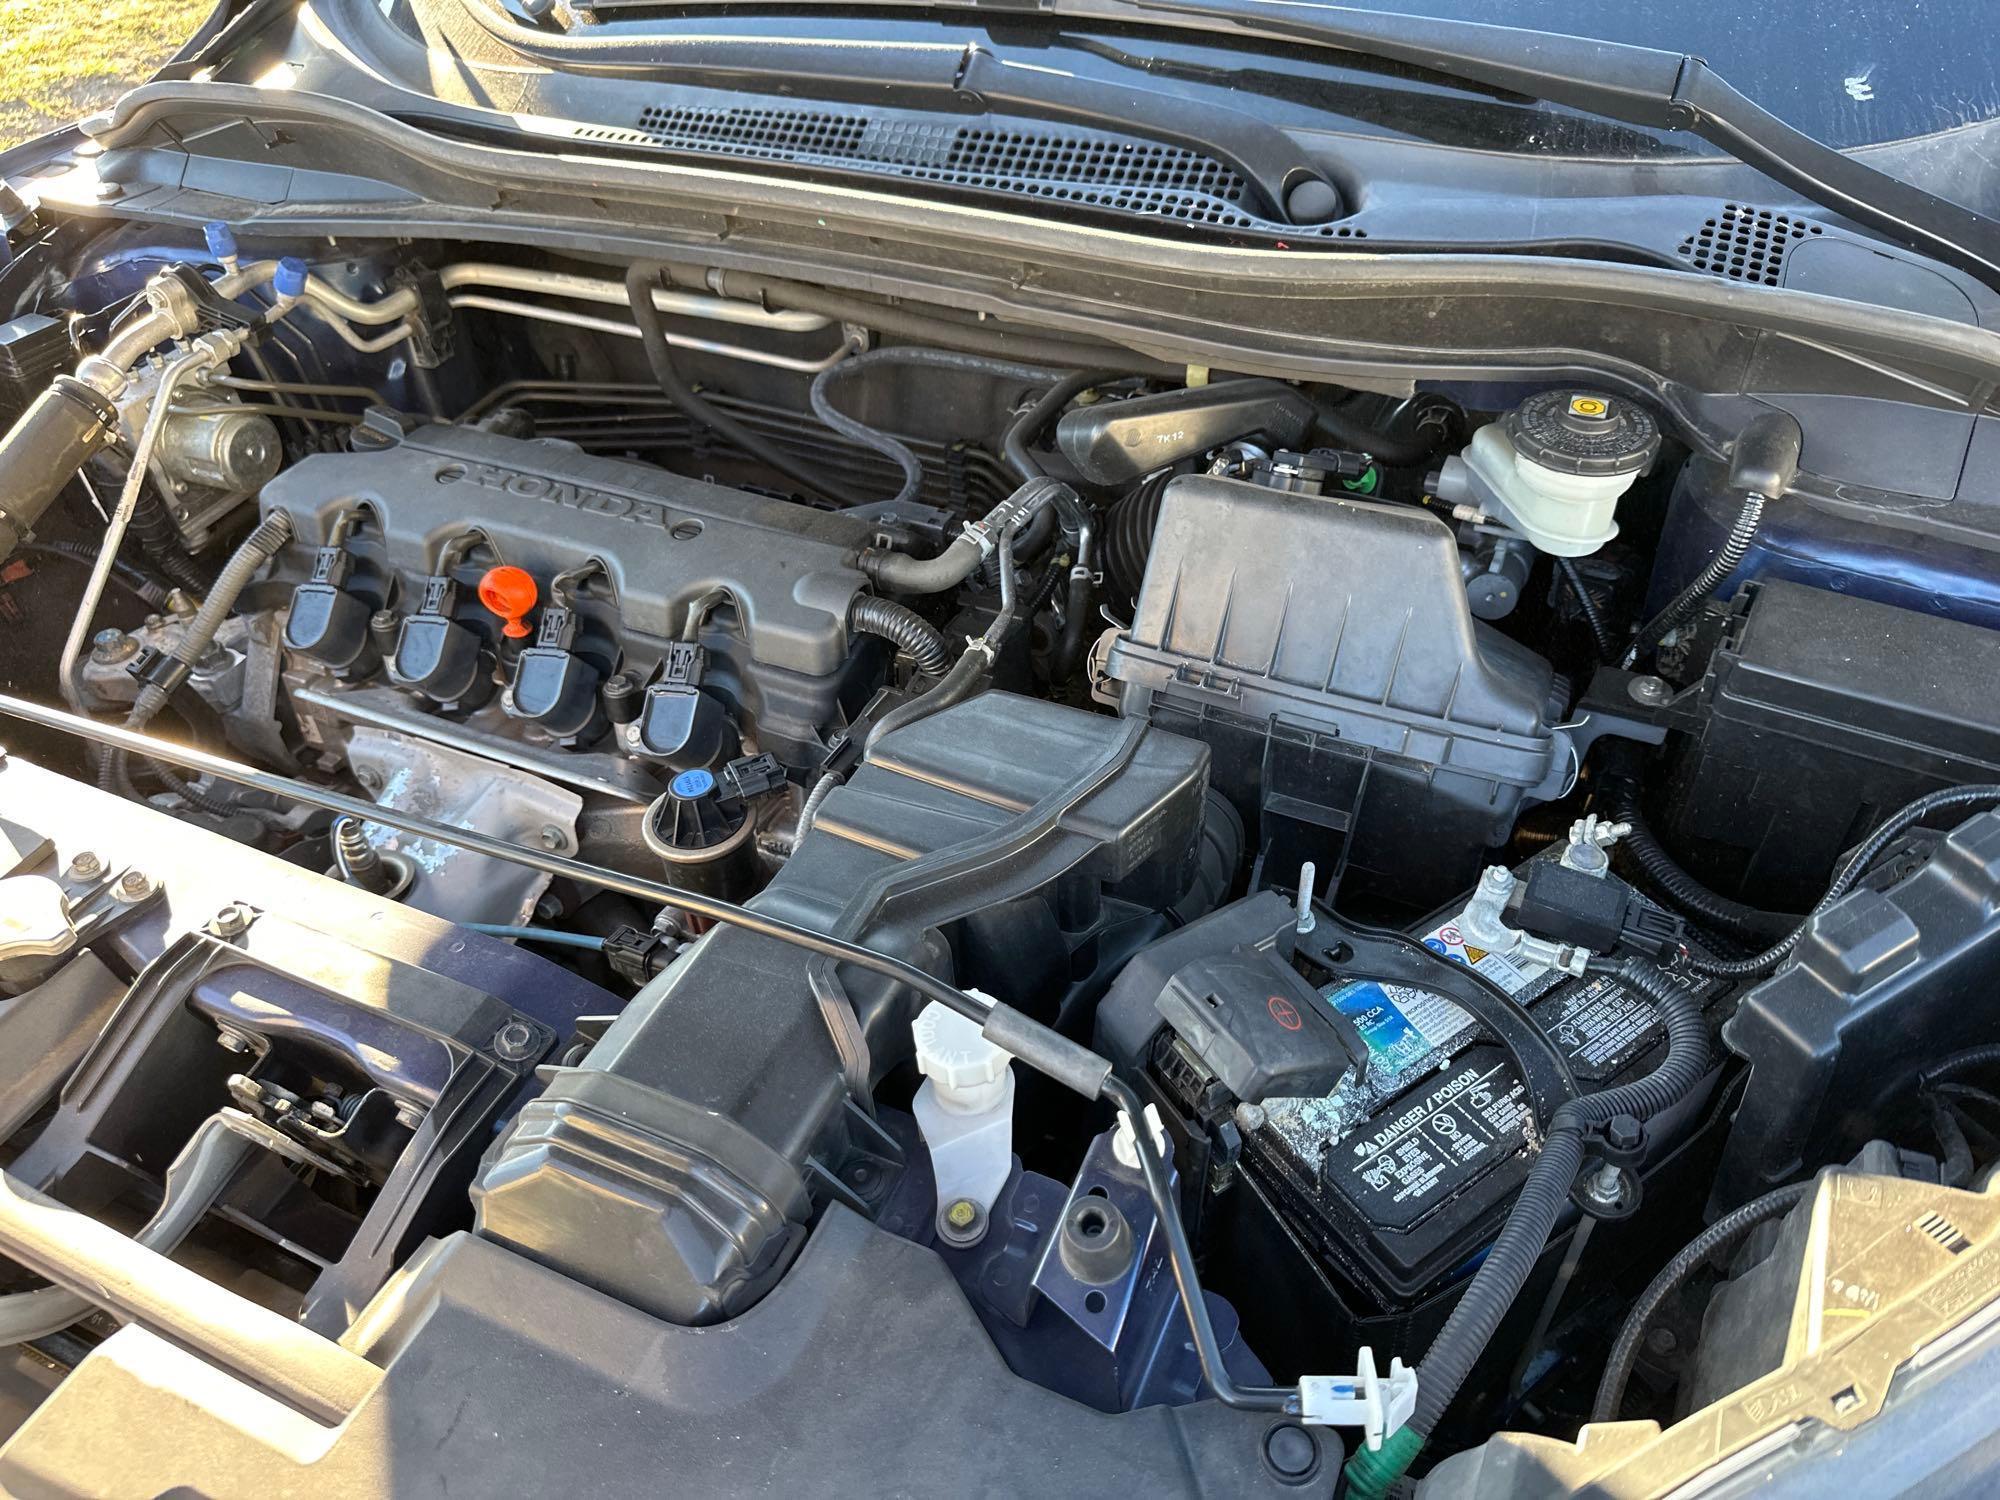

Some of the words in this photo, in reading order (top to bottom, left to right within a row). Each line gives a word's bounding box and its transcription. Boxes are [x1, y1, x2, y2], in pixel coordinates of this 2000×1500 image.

[462, 464, 669, 531] HONDA
[1352, 1013, 1368, 1025] 500
[1366, 1005, 1384, 1018] CCA
[1570, 1010, 1592, 1027] FLUSH
[1587, 1001, 1604, 1015] EYES
[1600, 985, 1627, 1005] IMMEDIA
[1577, 1018, 1596, 1032] WITH
[1611, 997, 1625, 1008] GET
[1584, 1017, 1612, 1038] MEDICAL
[1607, 1009, 1623, 1021] HELP
[1620, 999, 1636, 1012] FAST
[1374, 1105, 1425, 1145] DANGER
[1431, 1067, 1479, 1104] POISON
[1481, 1094, 1512, 1118] SULFURIC
[1509, 1084, 1526, 1098] ACID
[1394, 1136, 1420, 1156] SHIELD
[1449, 1130, 1462, 1141] NO
[1393, 1150, 1431, 1179] EXPLOSIVE
[1401, 1146, 1421, 1162] EYES
[1400, 1166, 1425, 1185] GASES
